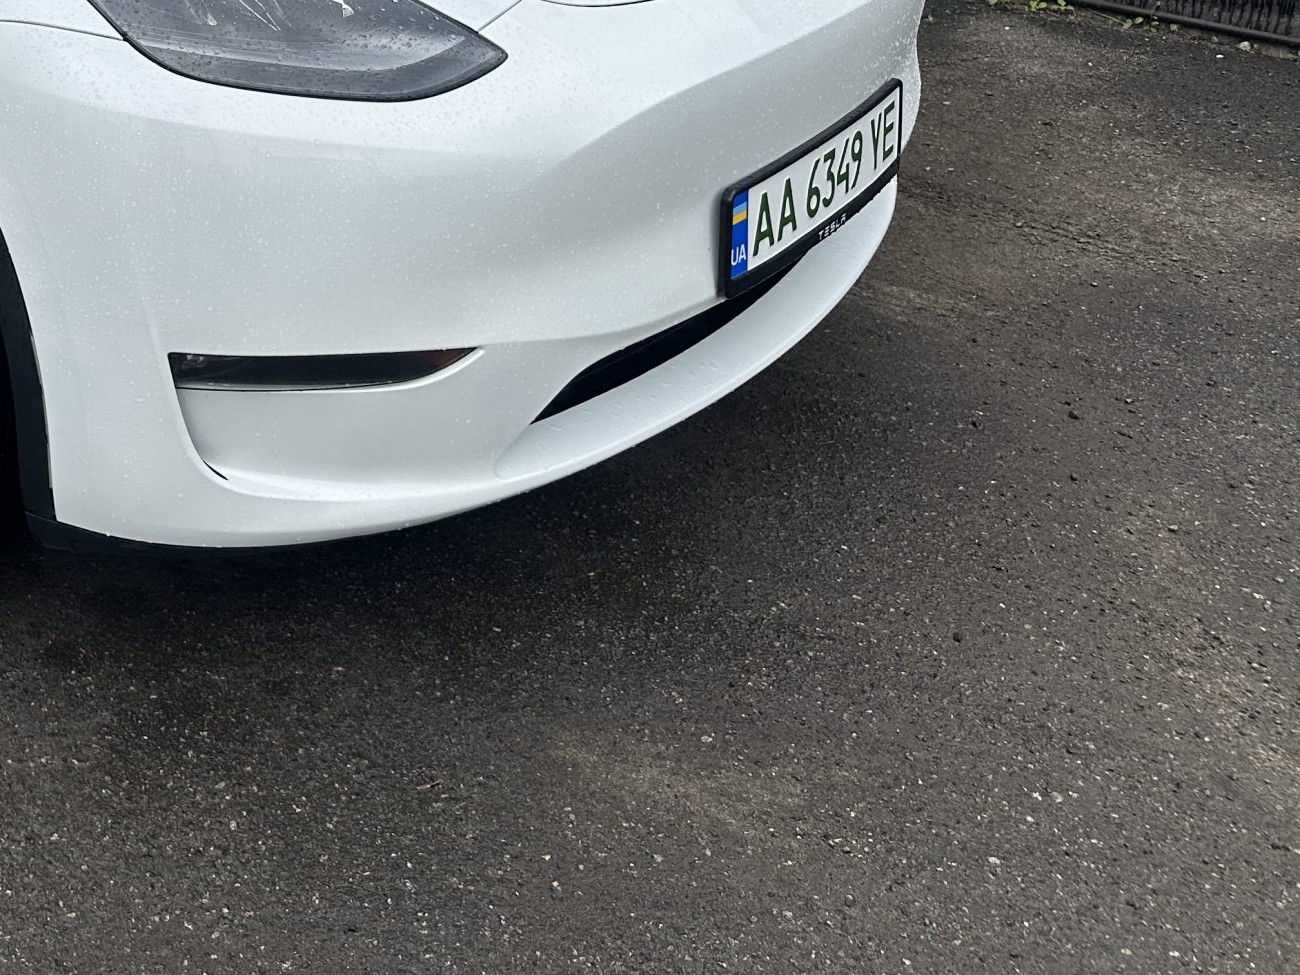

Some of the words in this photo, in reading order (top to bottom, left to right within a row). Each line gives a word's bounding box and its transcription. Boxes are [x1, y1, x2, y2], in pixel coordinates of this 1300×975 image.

[752, 177, 798, 257] AA
[806, 130, 863, 219] 6349
[870, 99, 896, 171] YE
[818, 212, 847, 241] TESLA
[730, 243, 747, 266] UA
